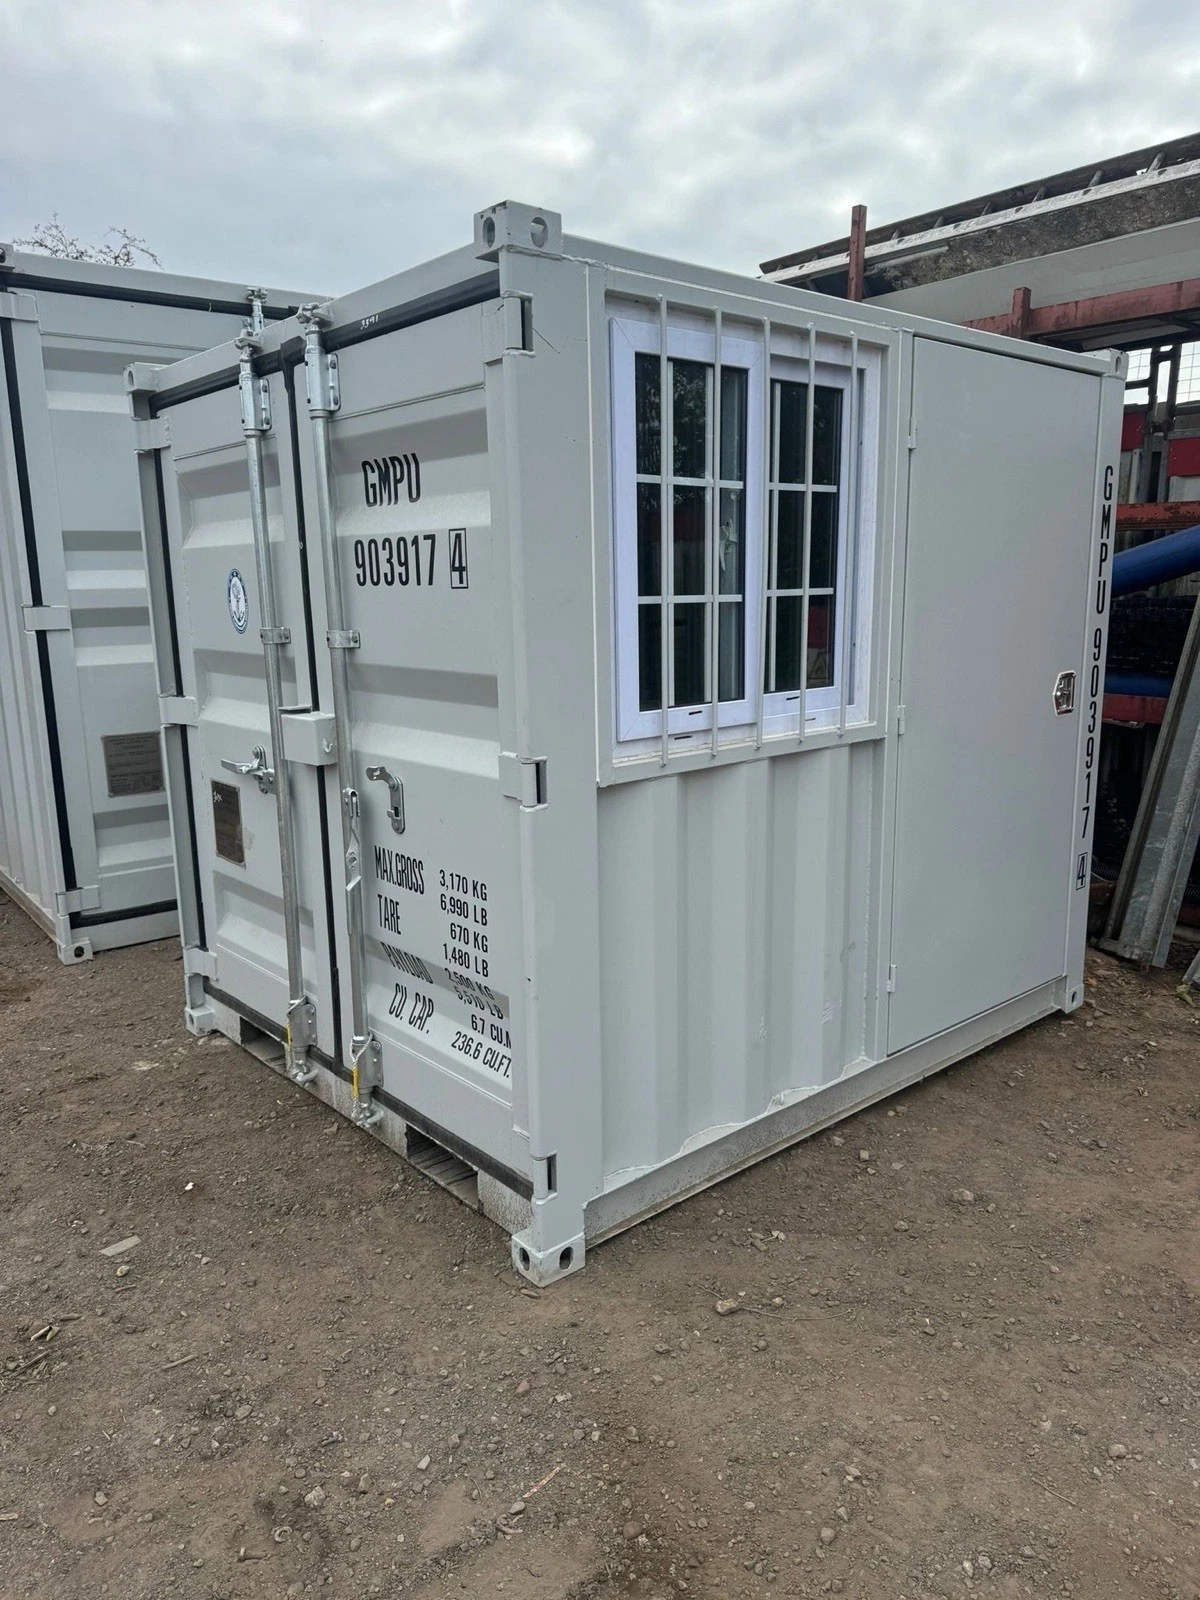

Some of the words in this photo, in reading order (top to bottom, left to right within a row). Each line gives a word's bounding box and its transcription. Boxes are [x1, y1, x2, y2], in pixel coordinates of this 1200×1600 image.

[361, 452, 421, 507] GMPU
[354, 533, 436, 587] 903917
[451, 532, 467, 586] 4
[1096, 465, 1114, 615] GMPU
[1081, 627, 1102, 839] 903917
[374, 845, 425, 895] MAX.GROSS
[439, 869, 468, 895] 3,170
[472, 881, 488, 902] KG
[1076, 855, 1086, 887] 4
[377, 894, 402, 935] TARE
[450, 923, 469, 945] 670
[473, 932, 488, 953] KG
[440, 893, 469, 919] 6,990
[474, 906, 488, 927] LB
[380, 941, 434, 984] PAYLOAD
[475, 981, 495, 1000] KG
[443, 943, 470, 970] 1,480
[475, 957, 489, 978] LB
[388, 982, 408, 1021] CU.
[408, 992, 434, 1034] CAP.
[471, 1014, 485, 1035] 6.7
[453, 985, 485, 1011] 5,510
[485, 1000, 504, 1020] LB
[451, 1031, 483, 1060] 236.6
